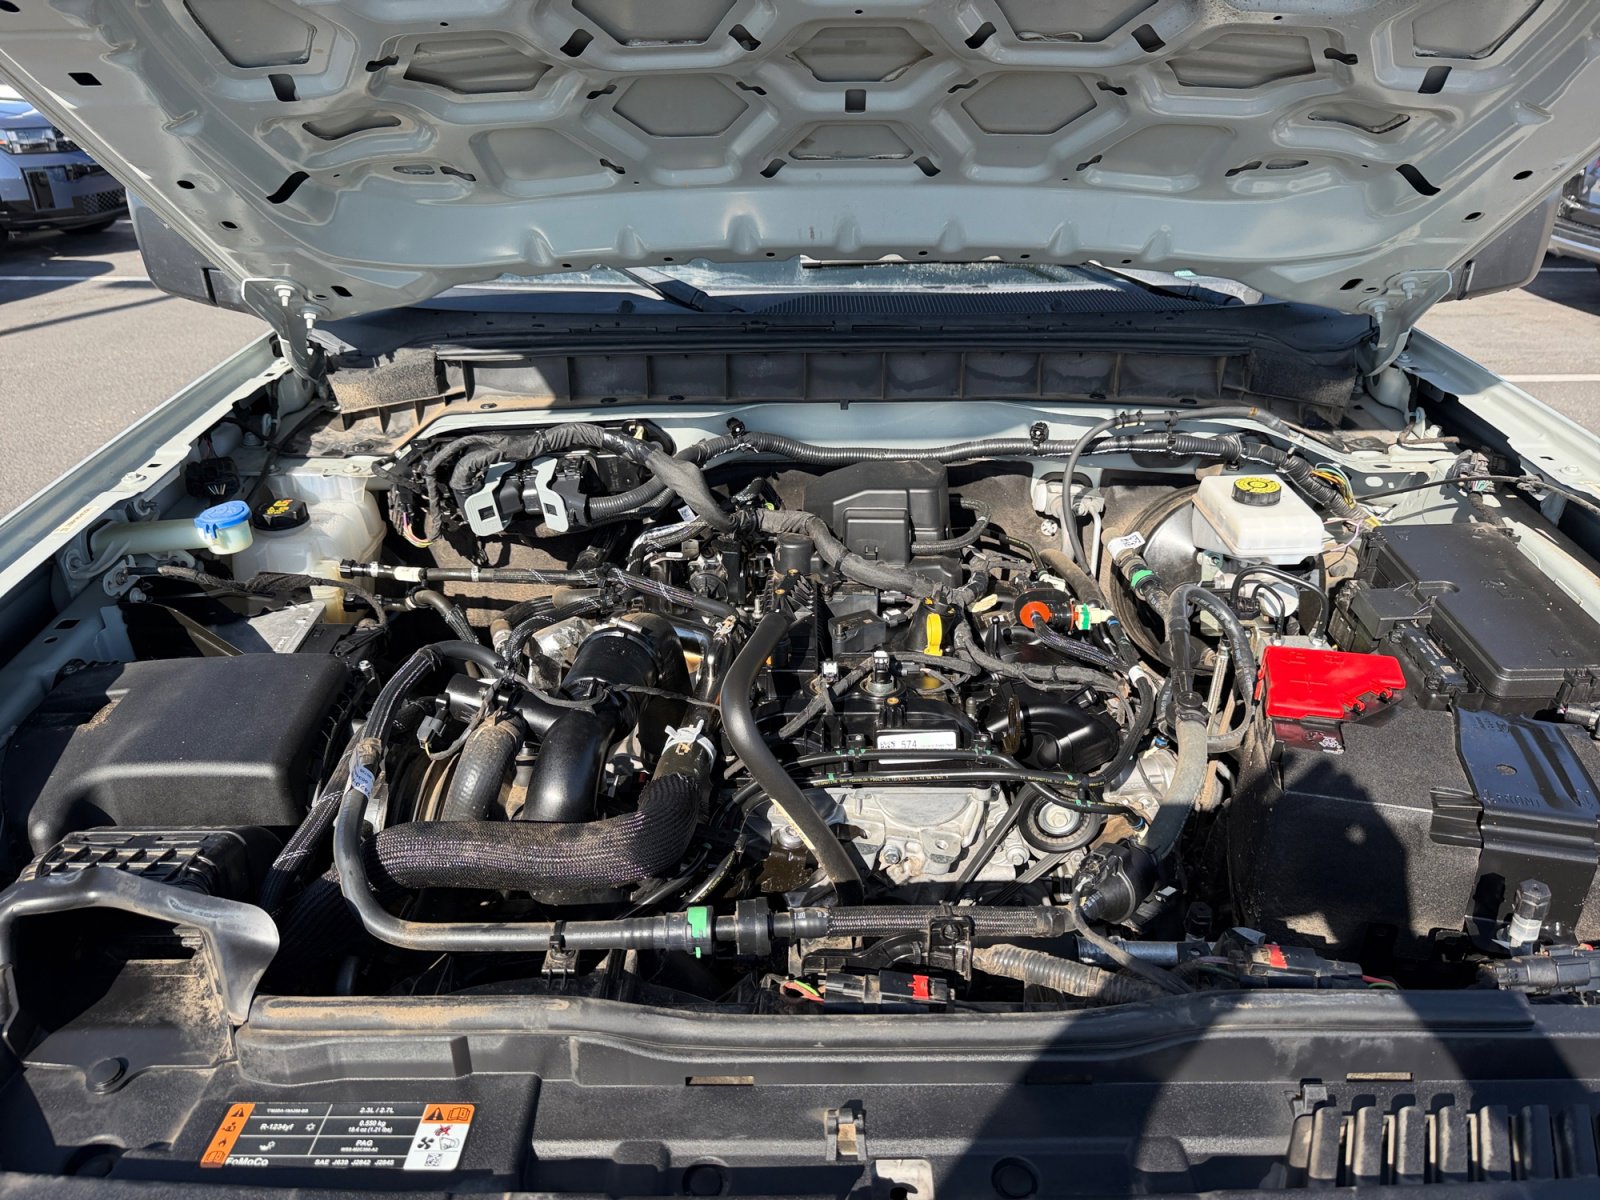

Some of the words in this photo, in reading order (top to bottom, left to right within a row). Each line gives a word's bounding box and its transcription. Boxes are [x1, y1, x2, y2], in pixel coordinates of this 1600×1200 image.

[359, 1106, 374, 1114] 2.3L
[379, 1106, 395, 1114] 2.7L
[377, 1119, 387, 1127] kg
[259, 1123, 295, 1132] R-1234yf
[224, 1157, 269, 1167] FoMoCo
[314, 1158, 330, 1166] SAE
